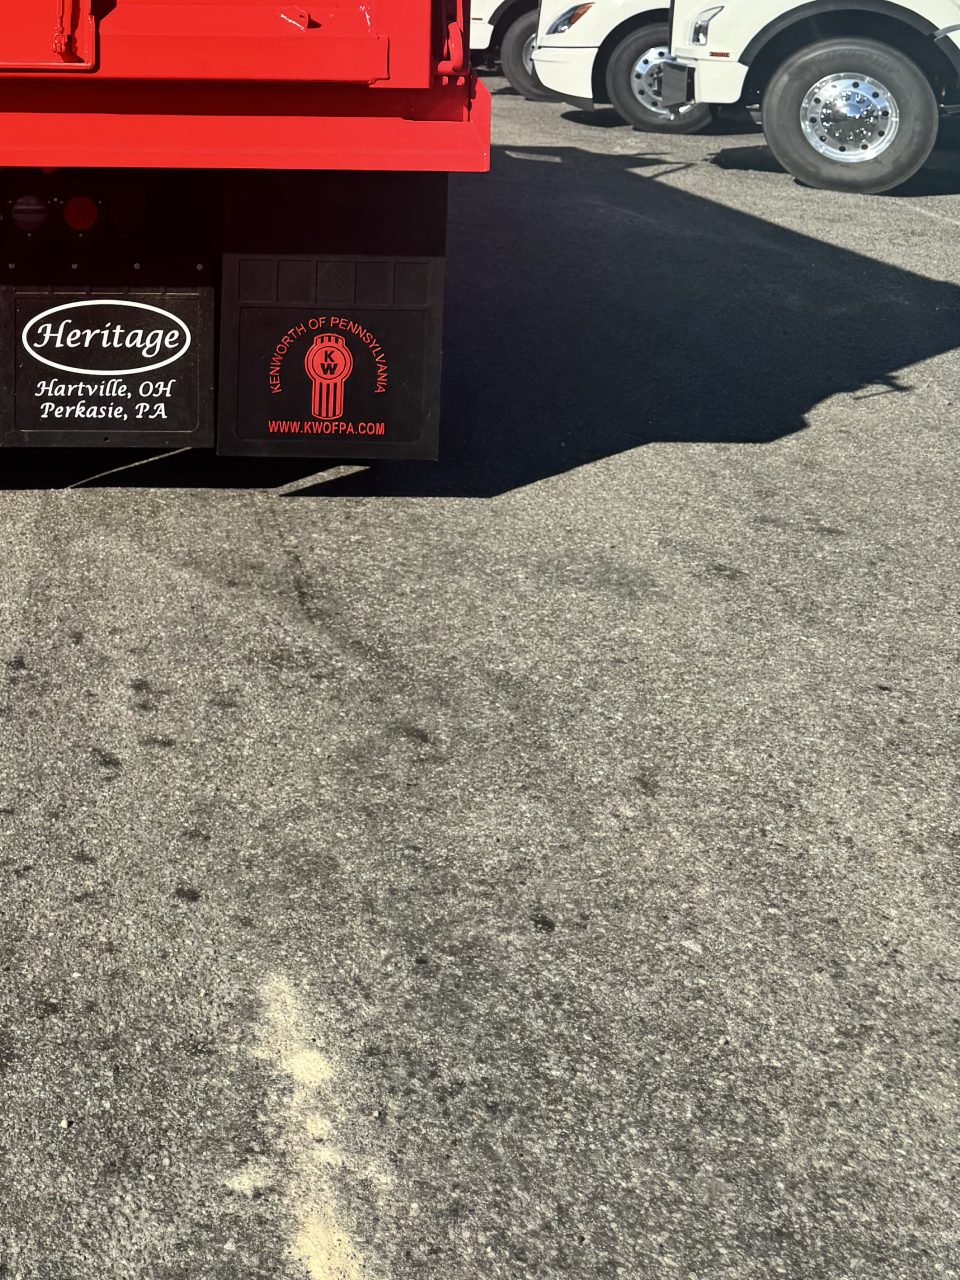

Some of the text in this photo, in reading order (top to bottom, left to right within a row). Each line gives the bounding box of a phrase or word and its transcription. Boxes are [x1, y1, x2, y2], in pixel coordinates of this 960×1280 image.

[33, 319, 180, 358] Heritage
[269, 316, 388, 394] KENWORTH OF PENNSYLVANIA
[34, 378, 176, 399] Hartville, OH
[40, 400, 168, 421] Perkasie, PA
[268, 420, 386, 436] WWW.KWOFPA.COM
